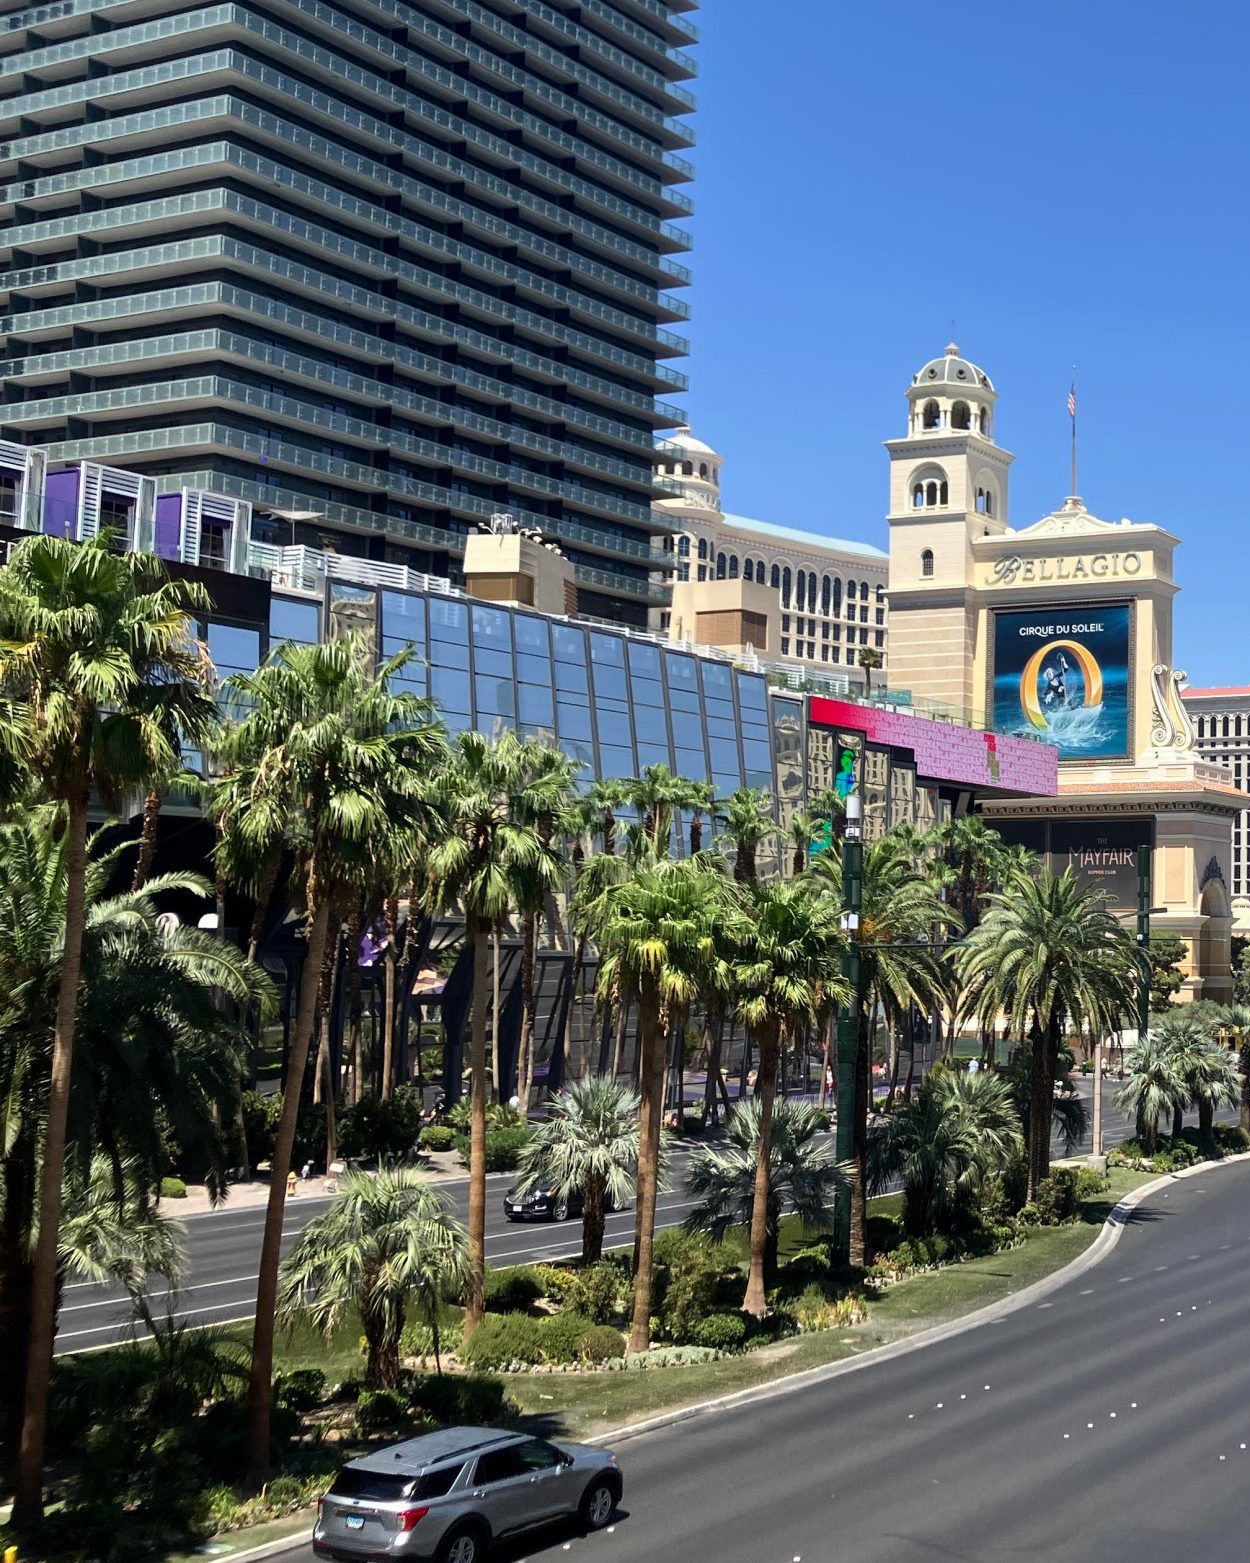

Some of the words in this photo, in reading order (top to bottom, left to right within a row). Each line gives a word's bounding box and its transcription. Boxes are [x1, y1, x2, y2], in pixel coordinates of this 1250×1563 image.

[985, 551, 1142, 586] BELLAGIO
[1019, 625, 1054, 637] CIRQUE
[1056, 624, 1070, 634] DU
[1072, 623, 1104, 633] SOLEIL
[1068, 846, 1135, 868] MAYFAIR
